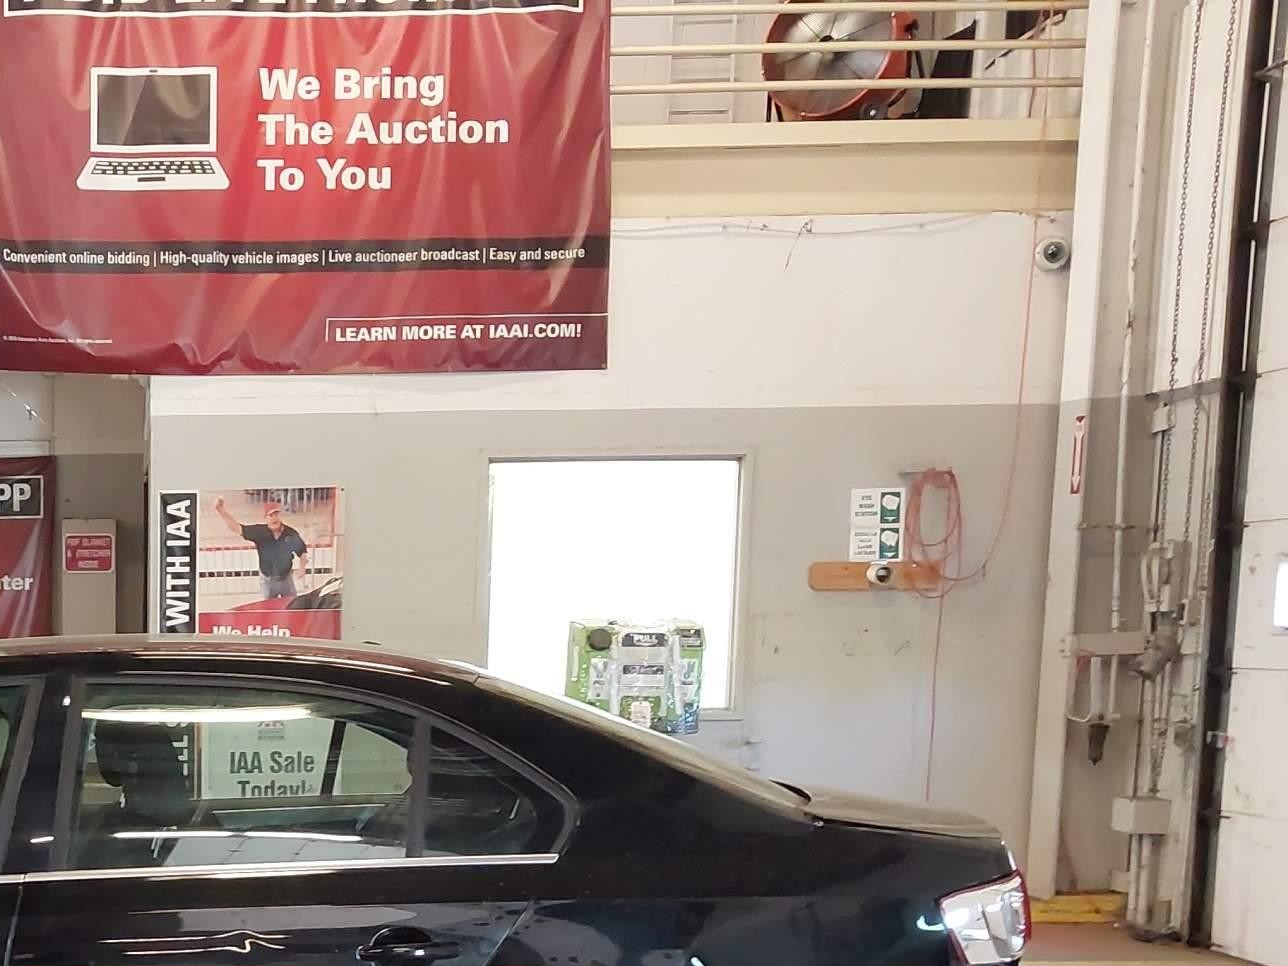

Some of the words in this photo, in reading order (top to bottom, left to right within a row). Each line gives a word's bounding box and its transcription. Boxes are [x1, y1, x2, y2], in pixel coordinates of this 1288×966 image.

[258, 67, 321, 100] We
[334, 66, 444, 106] Bring
[258, 113, 333, 145] The
[345, 111, 509, 144] Auction
[256, 159, 305, 191] To
[316, 158, 392, 190] You
[3, 248, 67, 264] Convenient
[70, 252, 104, 265] online
[107, 251, 150, 266] bidding
[160, 251, 230, 267] High-quality
[232, 251, 273, 264] vehicle
[276, 252, 319, 266] images
[328, 250, 352, 262] Live
[355, 250, 418, 263] auctioneer
[421, 248, 480, 261] broadcast
[489, 248, 516, 263] Easy
[520, 248, 541, 260] and
[544, 248, 585, 260] secure
[335, 326, 396, 342] LEARN
[402, 325, 457, 340] MORE
[461, 324, 485, 339] AT
[489, 323, 581, 339] IAAI.COM!
[166, 499, 191, 546] IAA
[165, 556, 190, 627] WITH
[230, 751, 264, 774] IAA
[270, 751, 315, 773] Sale
